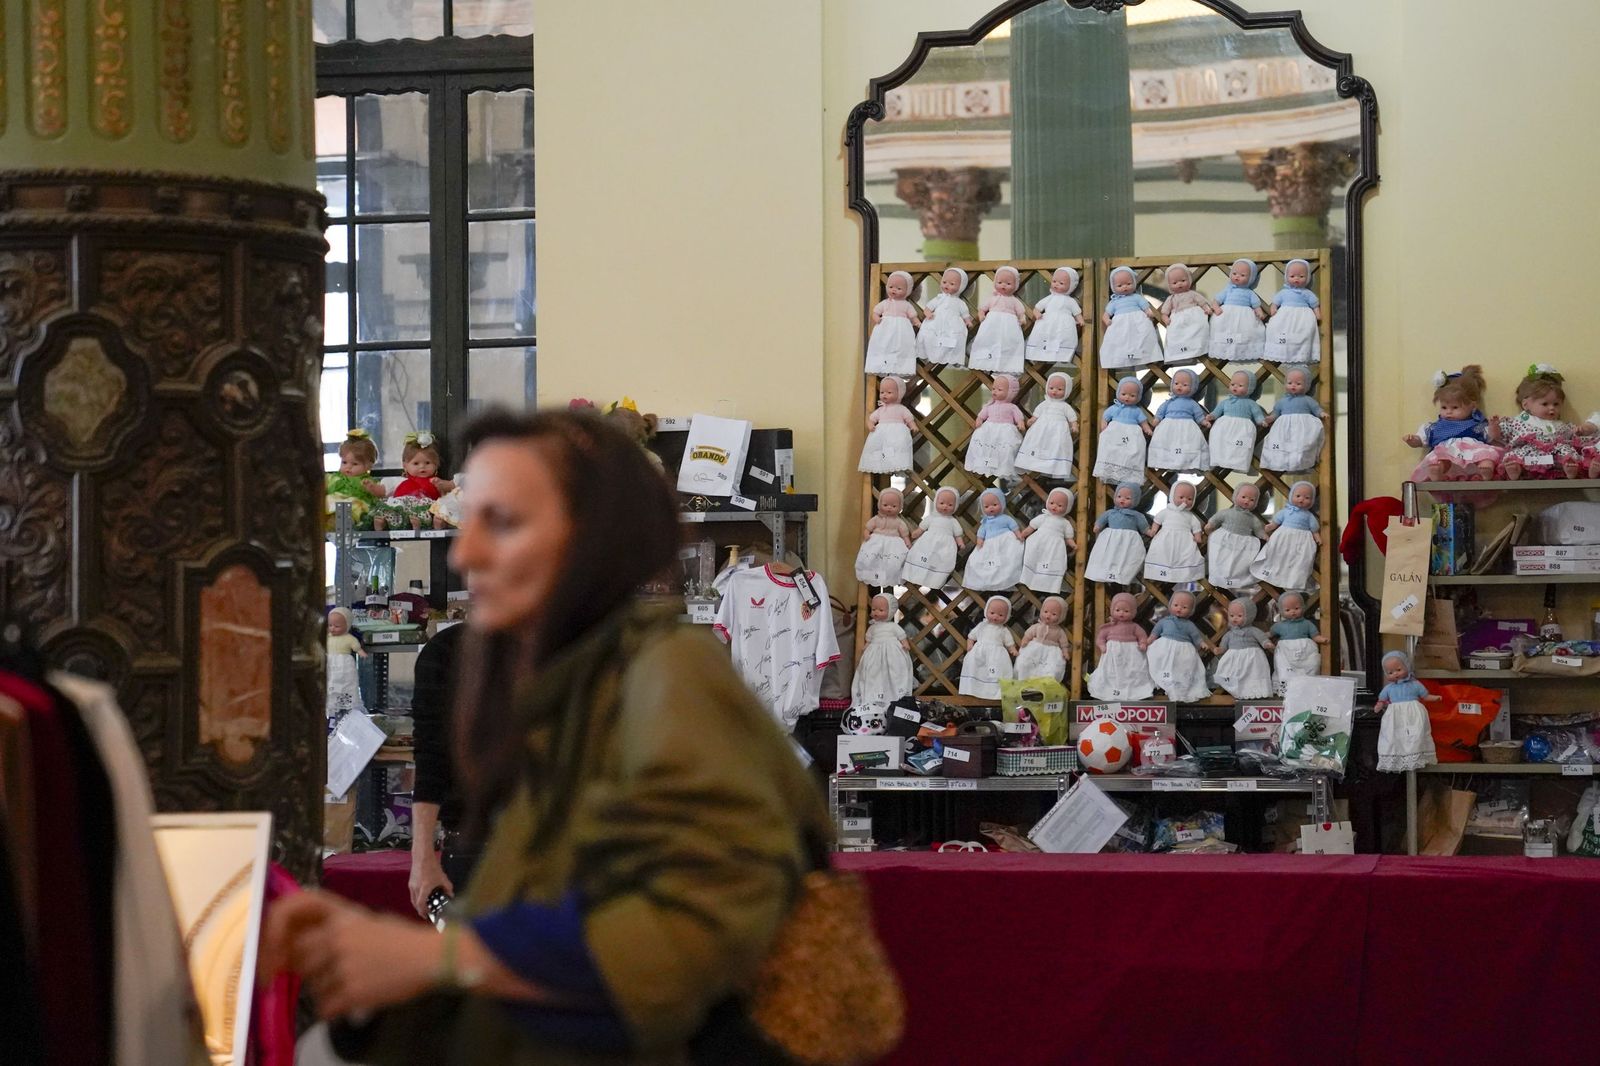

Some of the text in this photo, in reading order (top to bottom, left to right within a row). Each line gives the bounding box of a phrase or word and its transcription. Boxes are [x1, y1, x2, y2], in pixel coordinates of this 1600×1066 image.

[1389, 571, 1422, 583] GALÁN
[1316, 705, 1328, 713] 782
[903, 712, 915, 721] 709
[1015, 723, 1026, 731] 717
[946, 749, 958, 758] 714
[847, 820, 858, 828] 720
